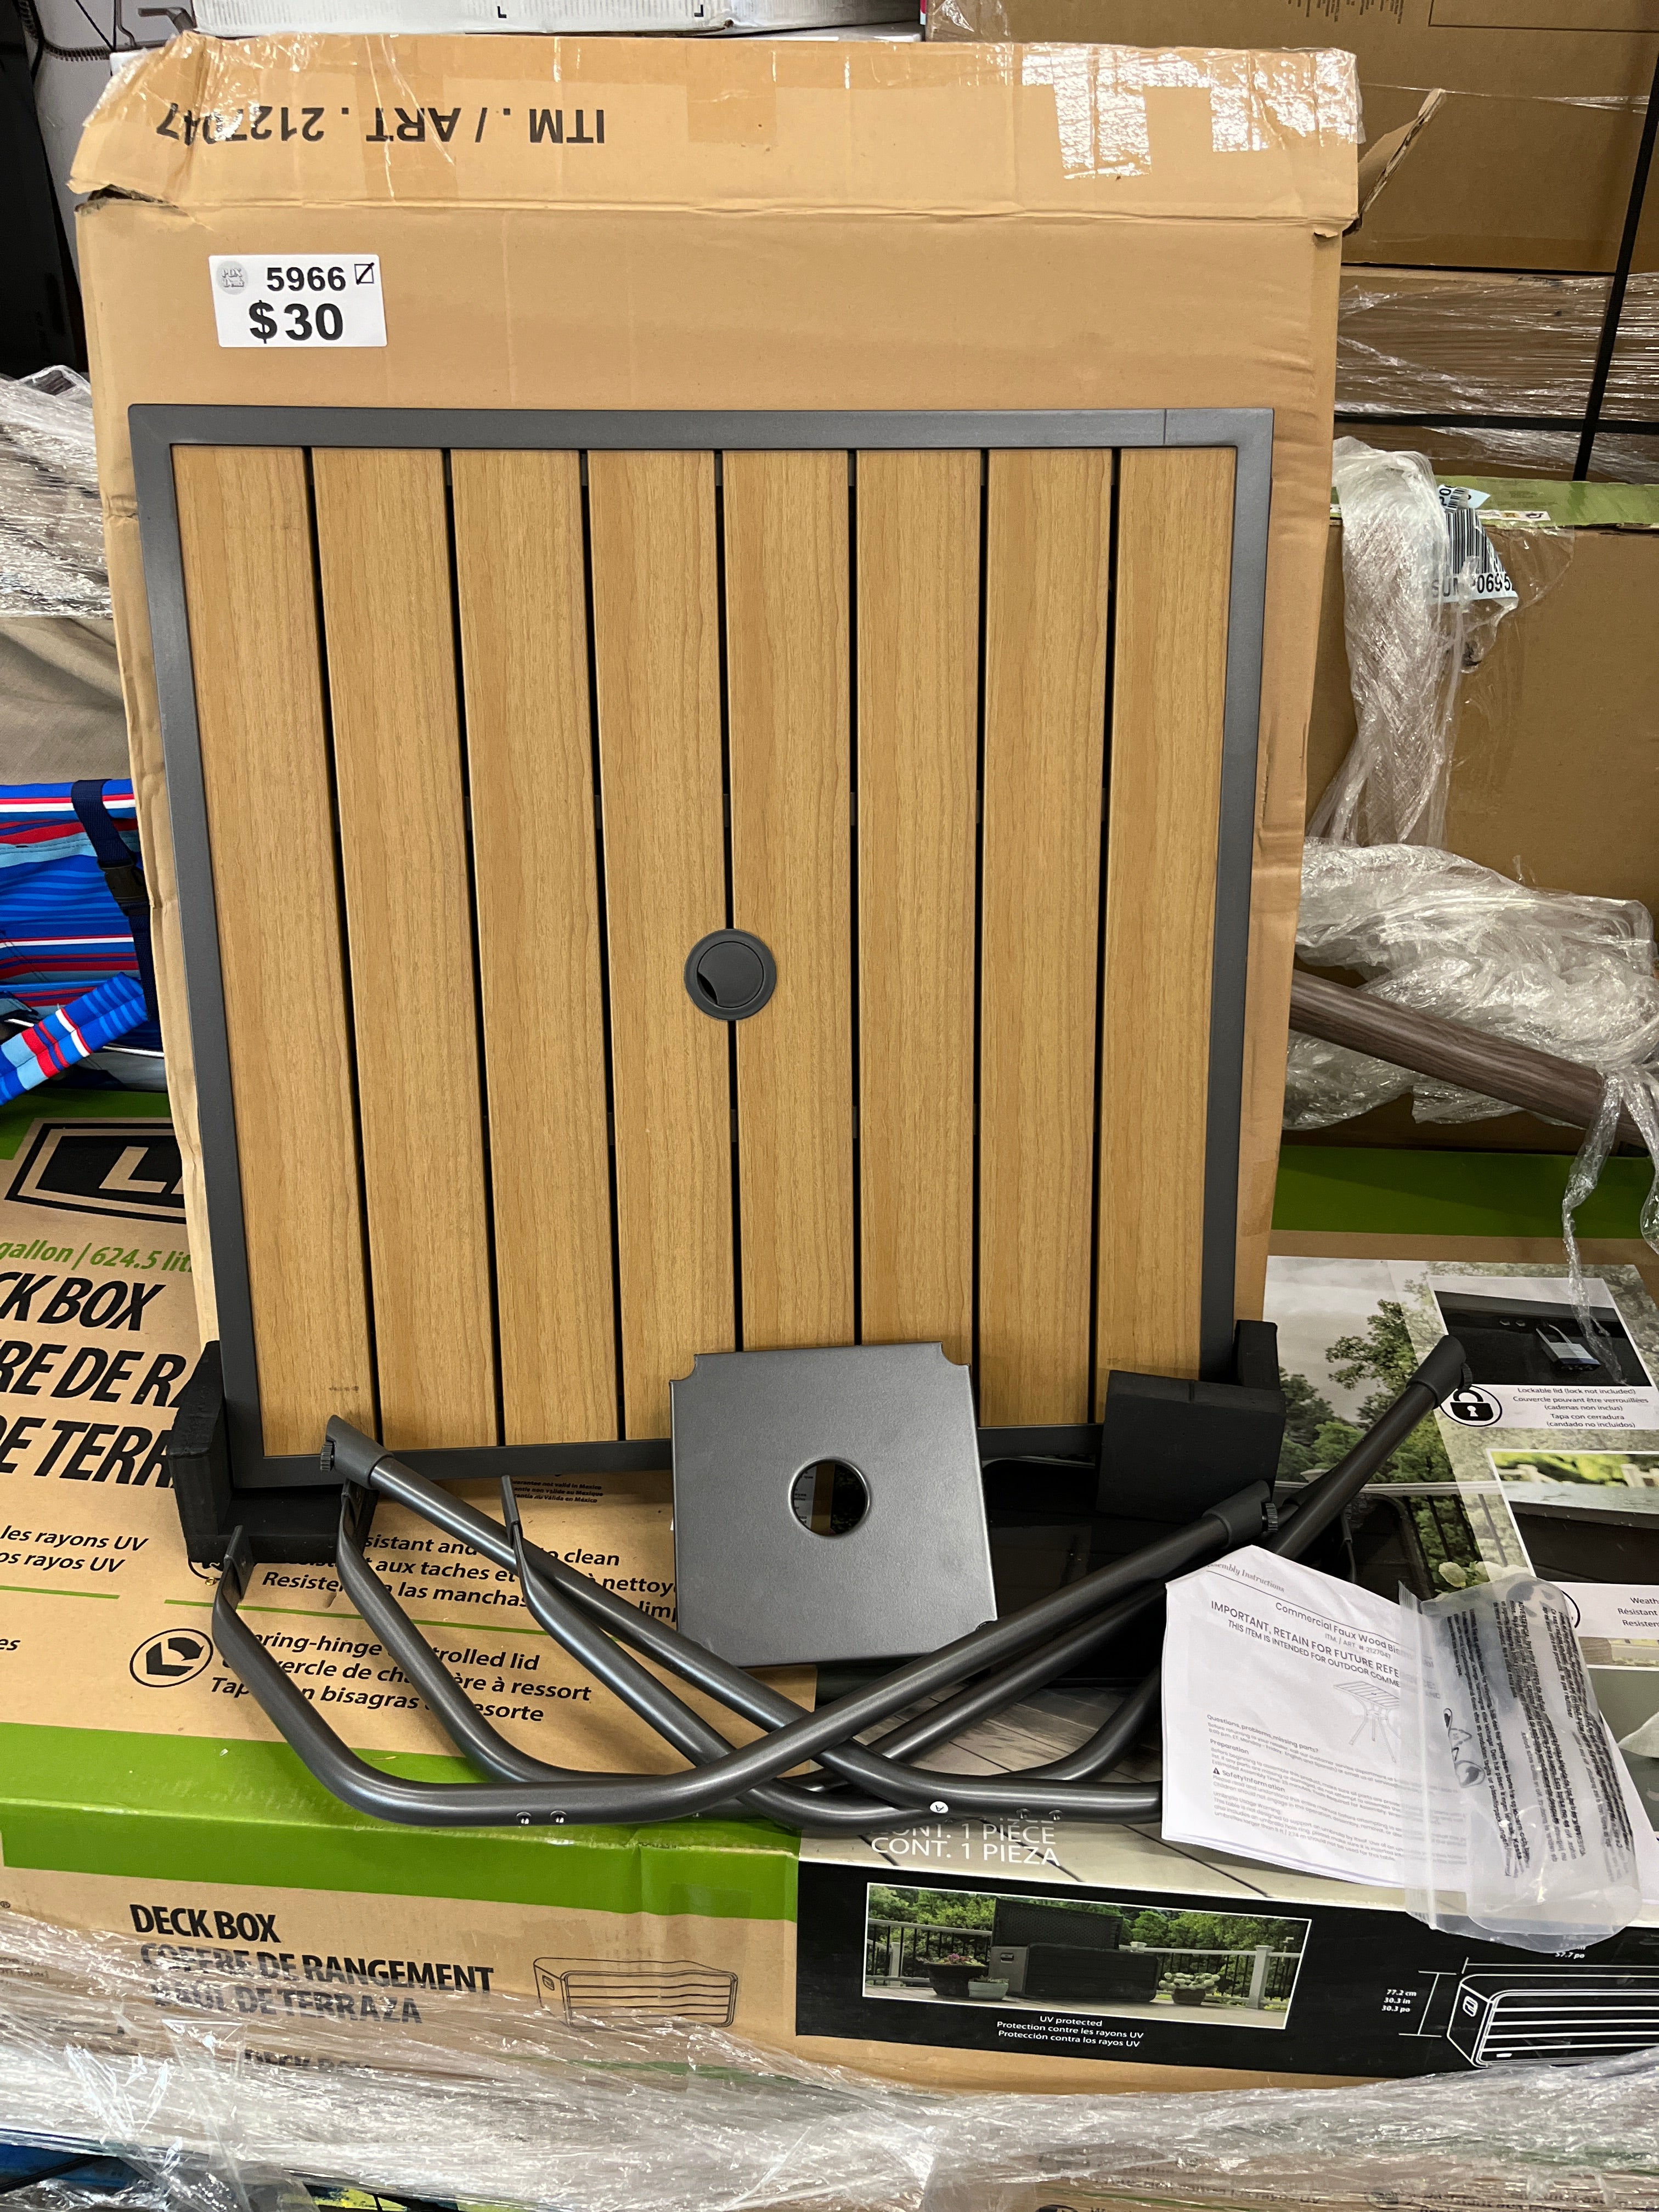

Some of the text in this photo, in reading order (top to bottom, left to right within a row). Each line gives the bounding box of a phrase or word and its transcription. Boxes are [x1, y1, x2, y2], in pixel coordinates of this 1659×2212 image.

[267, 267, 346, 291] 5966
[249, 300, 343, 344] $30
[90, 1246, 162, 1269] 624.5
[37, 1277, 166, 1331] BOX
[50, 1347, 145, 1403] DE
[131, 1353, 192, 1408] R
[33, 1420, 175, 1488] TERR
[2, 1525, 149, 1551] les rayons UV
[364, 1534, 433, 1552] sistant
[564, 1548, 619, 1566] clean
[24, 1555, 85, 1571] rayos
[90, 1557, 126, 1572] UV
[375, 1560, 416, 1574] aux
[421, 1561, 490, 1580] taches
[603, 1577, 676, 1597] nettoy
[398, 1582, 428, 1598] las
[1242, 1569, 1285, 1592] Instructions
[1276, 1602, 1332, 1630] Commercial
[1333, 1625, 1356, 1640] Faux
[1358, 1634, 1386, 1649] Wood
[510, 1653, 540, 1671] lid
[1228, 1620, 1244, 1633] THIS
[1245, 1627, 1262, 1640] ITEM
[1264, 1634, 1271, 1643] IS
[1272, 1638, 1310, 1657] INTENDED
[1311, 1652, 1326, 1664] FOR
[1328, 1658, 1369, 1676] OUTDOOR
[1274, 1626, 1309, 1647] RETAIN
[1311, 1641, 1332, 1656] FOR
[1334, 1649, 1374, 1669] FUTURE
[1366, 1646, 1391, 1660] 2127047
[342, 1663, 372, 1680] de
[492, 1677, 505, 1693] à
[511, 1682, 592, 1701] ressort
[211, 1677, 250, 1698] Tap
[320, 1685, 420, 1709] bisagras
[474, 1703, 544, 1722] esorte
[1210, 1738, 1249, 1754] Preparation
[961, 1823, 970, 1839] 1
[871, 1837, 1060, 1866] CONT. 1 PIEZA
[129, 1904, 281, 1943] DECK BOX
[302, 1955, 494, 1993] RANGEMENT
[997, 2021, 1046, 2030] Protection
[1048, 2025, 1079, 2034] contre
[1096, 2030, 1127, 2038] rayons
[998, 2030, 1048, 2040] Protección
[1055, 2018, 1103, 2027] protected
